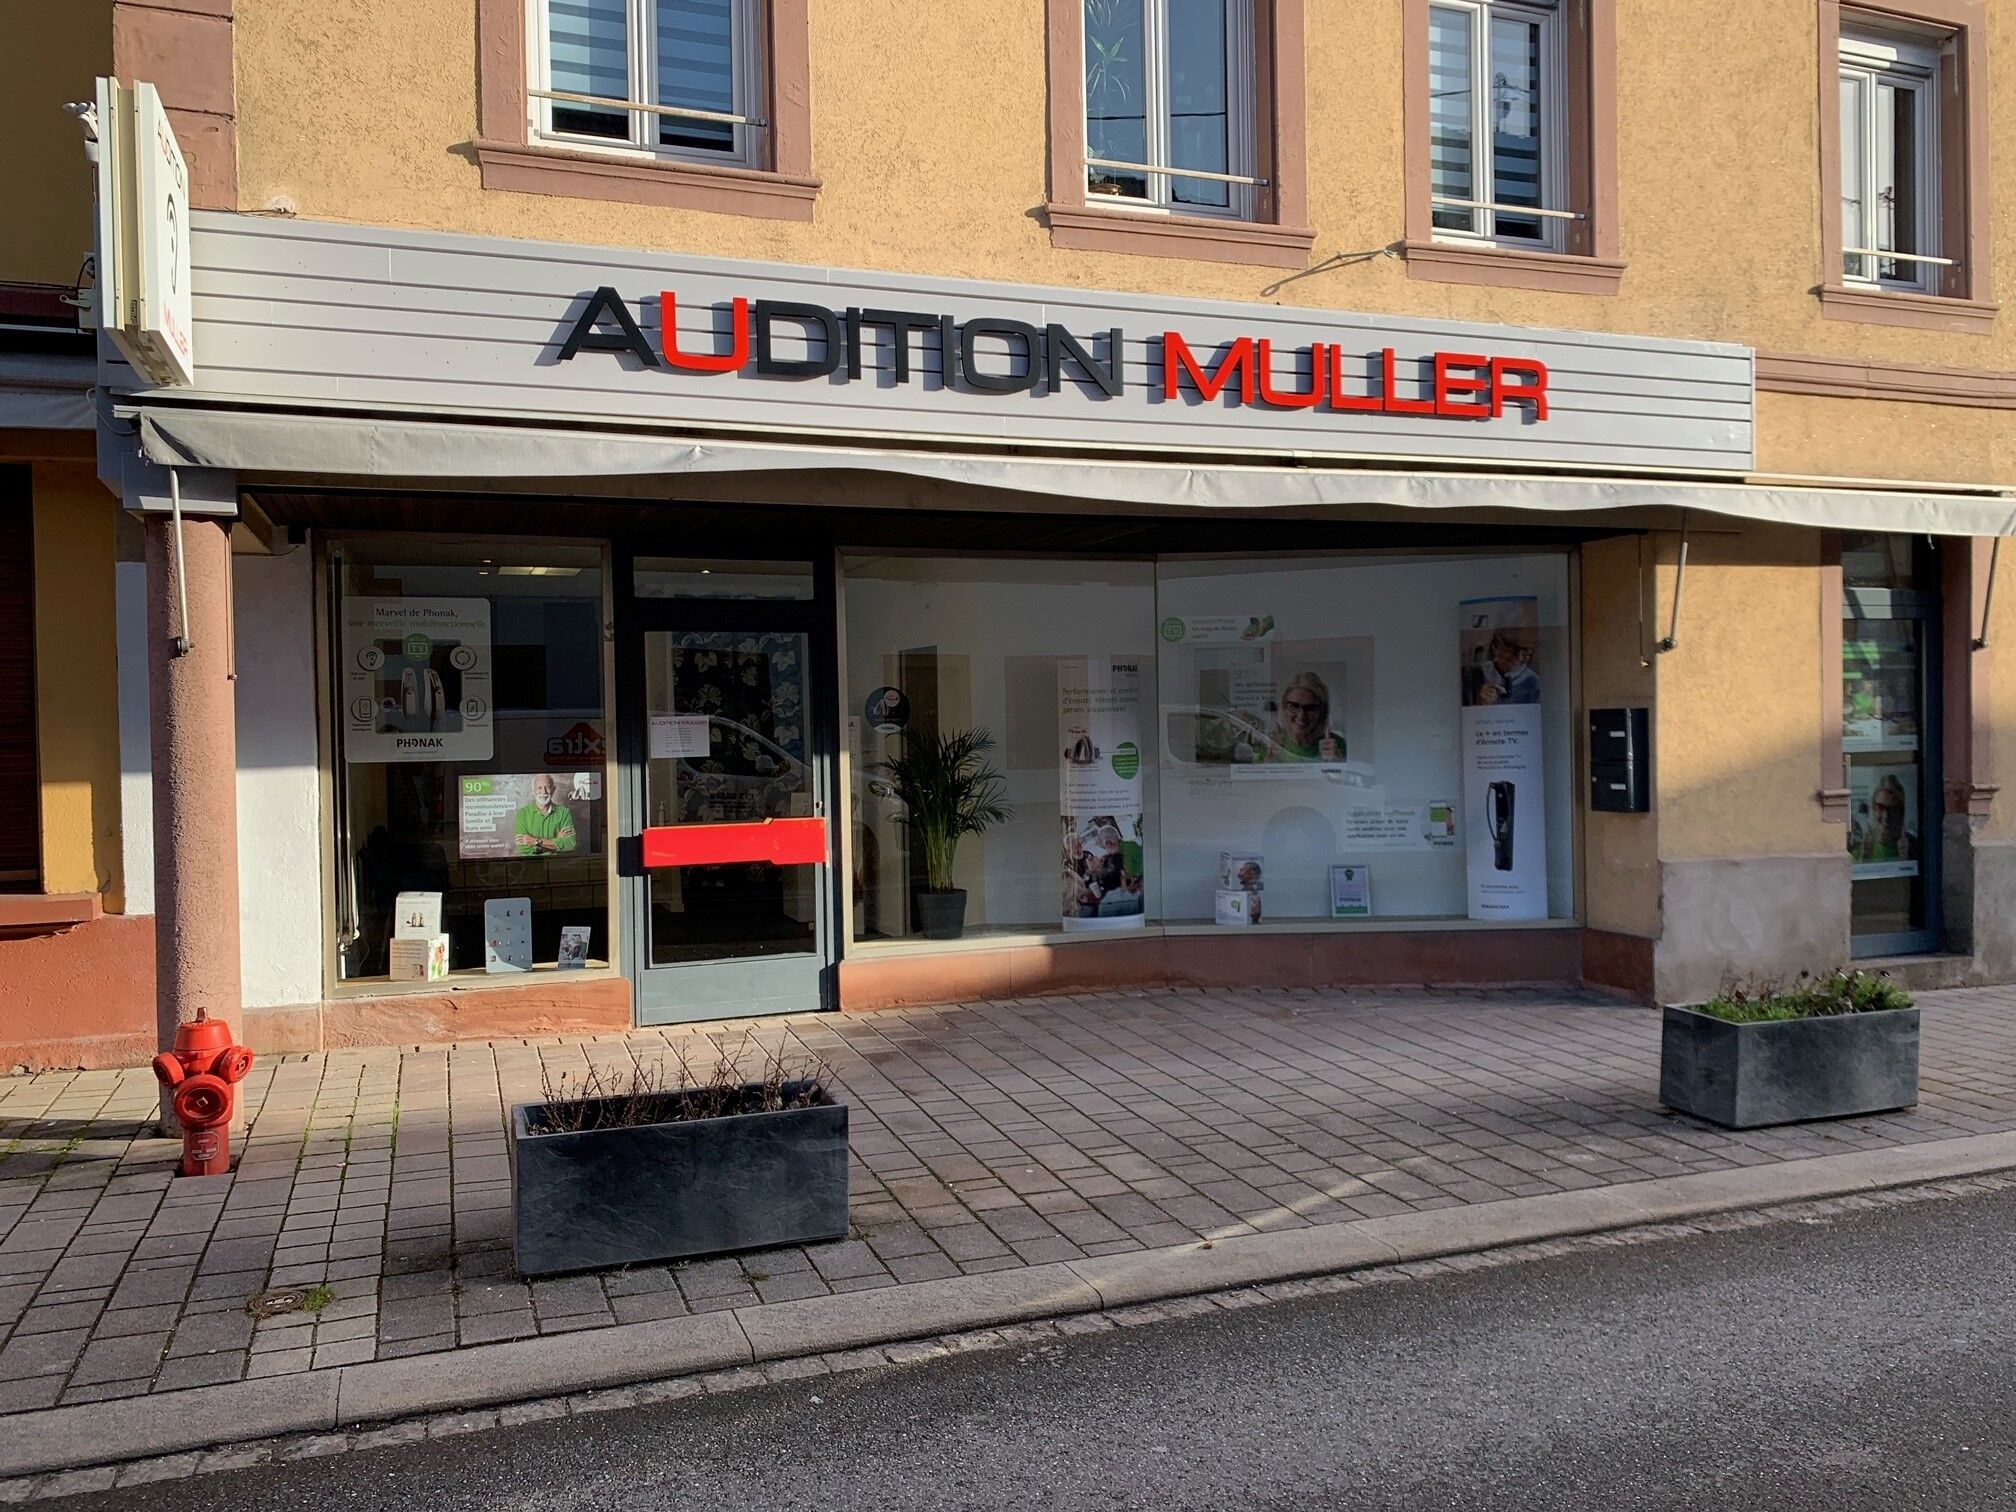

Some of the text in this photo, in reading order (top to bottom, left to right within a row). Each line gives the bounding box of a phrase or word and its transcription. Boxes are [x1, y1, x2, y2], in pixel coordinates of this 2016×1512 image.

[557, 286, 1548, 421] AUDITION MULLER
[375, 608, 458, 618] Marvel de Phonak,
[396, 738, 443, 748] PHONAK
